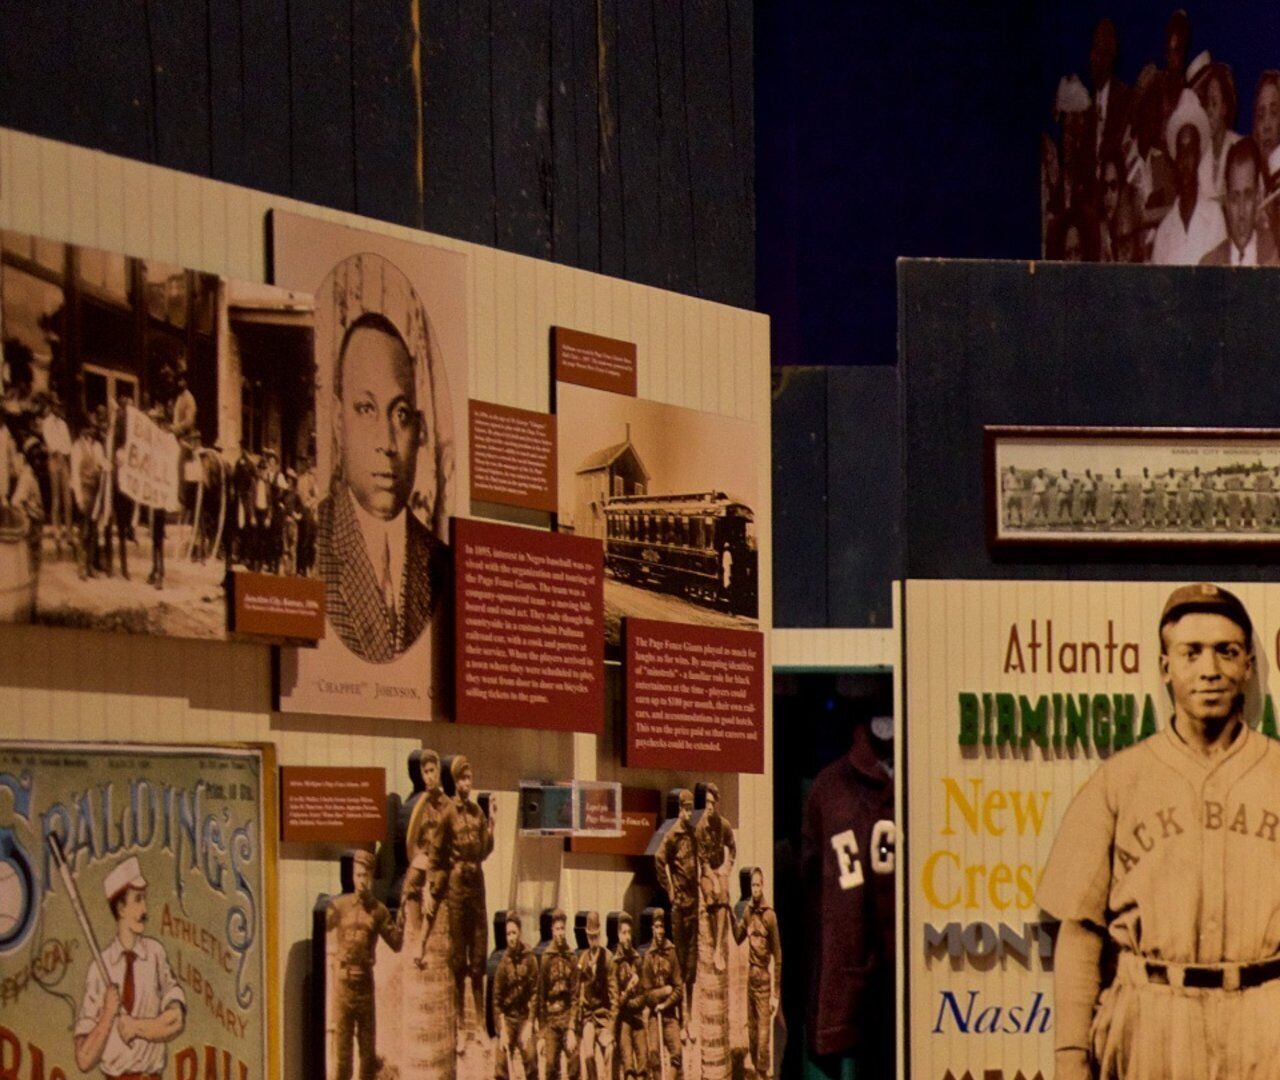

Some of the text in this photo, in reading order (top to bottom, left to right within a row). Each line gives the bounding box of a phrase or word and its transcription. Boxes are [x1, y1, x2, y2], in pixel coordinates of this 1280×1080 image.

[1002, 619, 1141, 675] Atlanta
[940, 777, 1051, 837] New
[921, 848, 1046, 911] Cres
[159, 902, 235, 974] ATHLETIC
[176, 960, 249, 1039] LIBRARY
[932, 990, 1052, 1035] Nash
